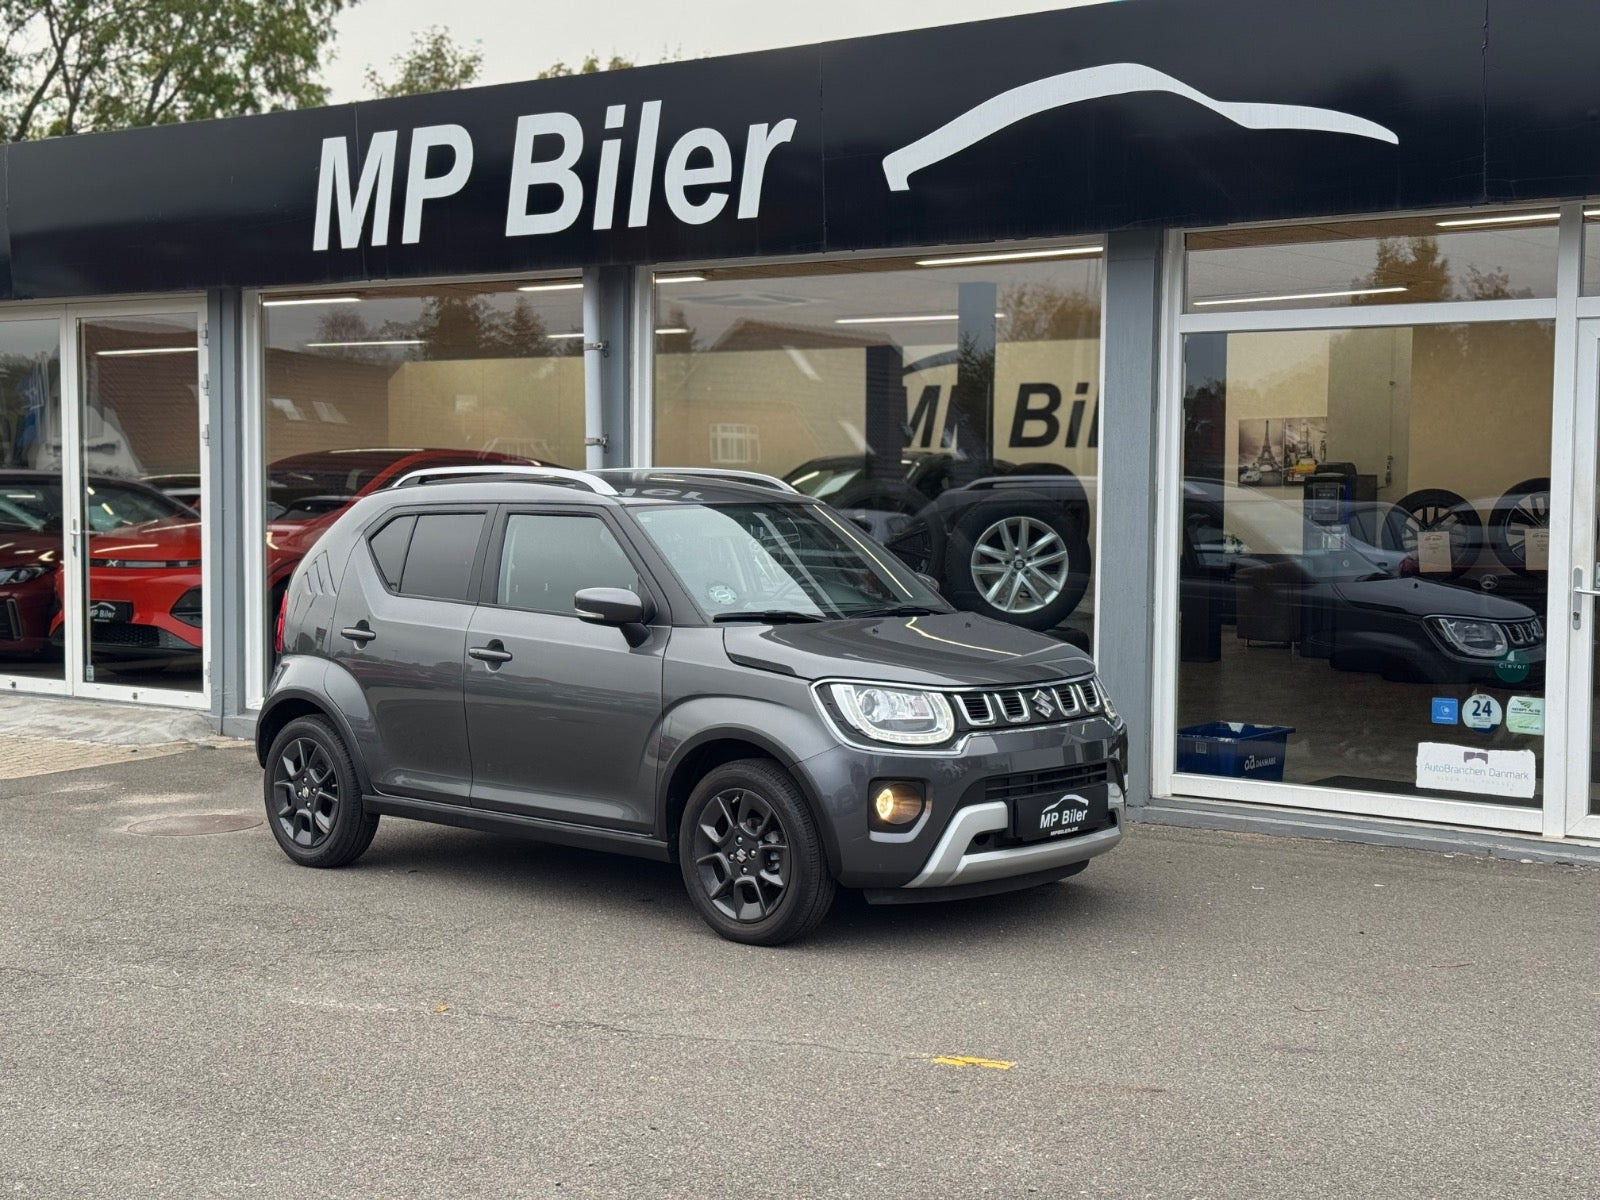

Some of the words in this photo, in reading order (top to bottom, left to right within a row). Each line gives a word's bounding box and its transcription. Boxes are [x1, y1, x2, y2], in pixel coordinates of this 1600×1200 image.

[312, 124, 474, 252] MP
[505, 100, 797, 238] Biler
[902, 385, 958, 448] M
[1498, 662, 1527, 670] Clever
[1471, 700, 1492, 717] 24
[1424, 763, 1486, 777] AutoBranchen
[1488, 767, 1529, 780] Danmark
[1040, 812, 1059, 829] MP
[1061, 809, 1088, 825] Biler
